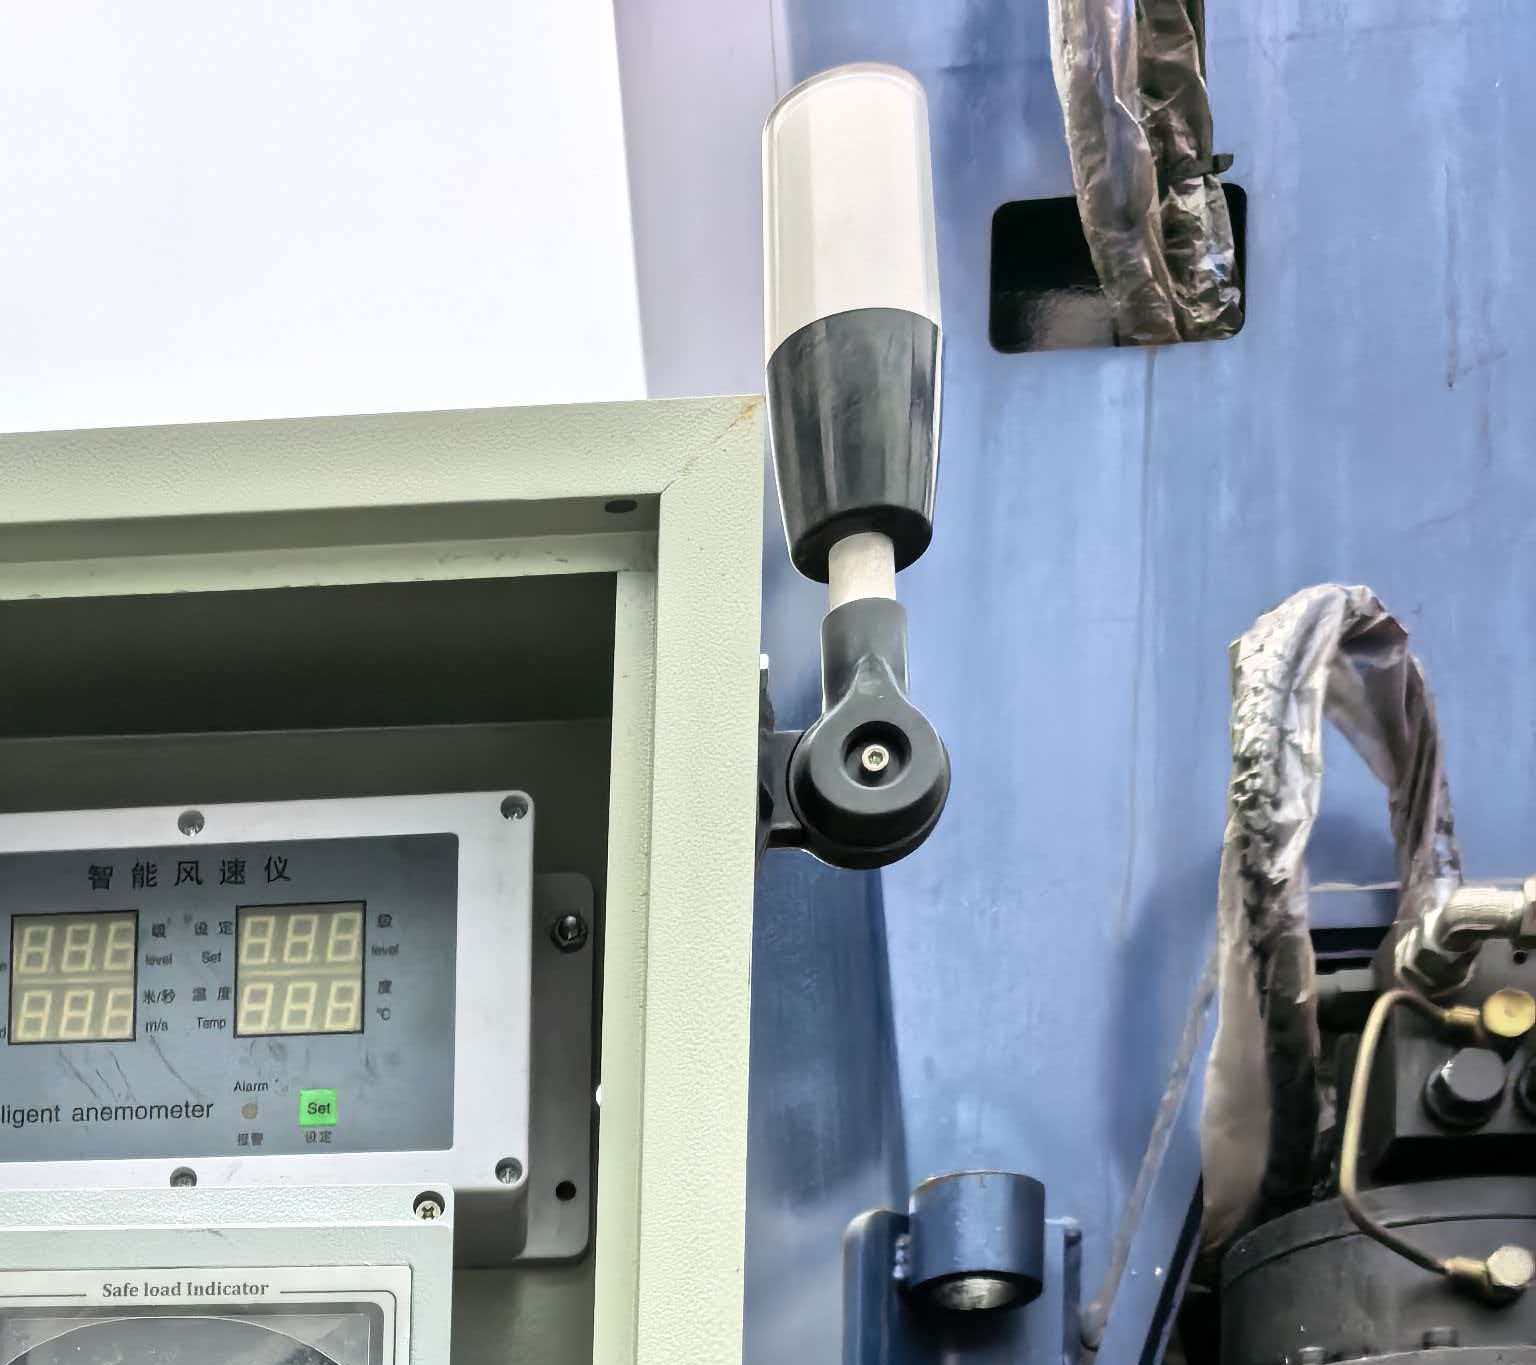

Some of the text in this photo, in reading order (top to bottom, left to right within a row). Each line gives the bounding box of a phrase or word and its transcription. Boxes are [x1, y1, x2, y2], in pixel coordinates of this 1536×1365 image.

[87, 854, 291, 890] 智能风速仪
[200, 950, 222, 965] Set
[145, 1018, 169, 1033] m/s
[197, 1016, 226, 1031] Temp
[233, 1079, 269, 1093] Alarm
[71, 1099, 215, 1122] anemometer
[307, 1101, 331, 1115] Set
[102, 1280, 270, 1297] Safe load Indicator
